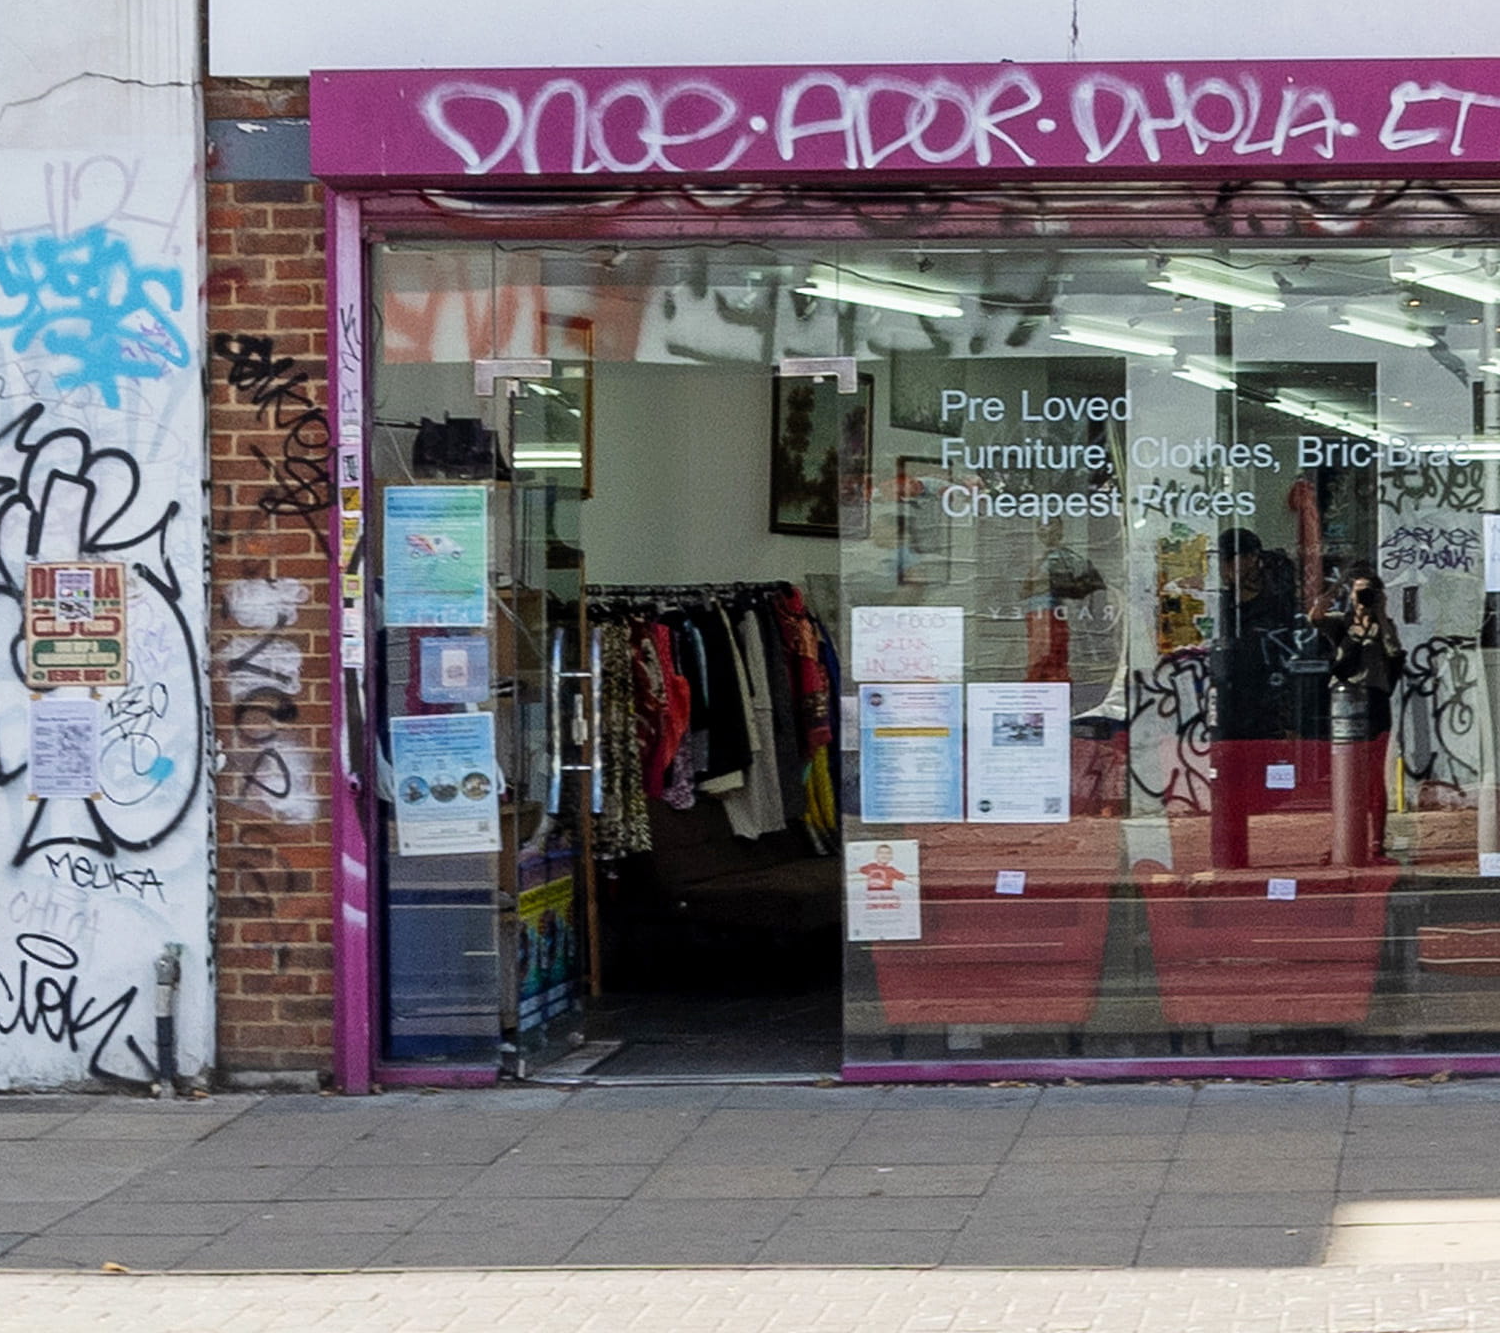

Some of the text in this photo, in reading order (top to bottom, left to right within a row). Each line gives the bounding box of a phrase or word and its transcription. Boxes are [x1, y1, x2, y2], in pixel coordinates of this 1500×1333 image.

[941, 389, 1134, 422] Pre Loved
[941, 436, 1475, 473] Furniture, Clothes, Bric-Brac
[941, 483, 1257, 524] Cheapest Prices
